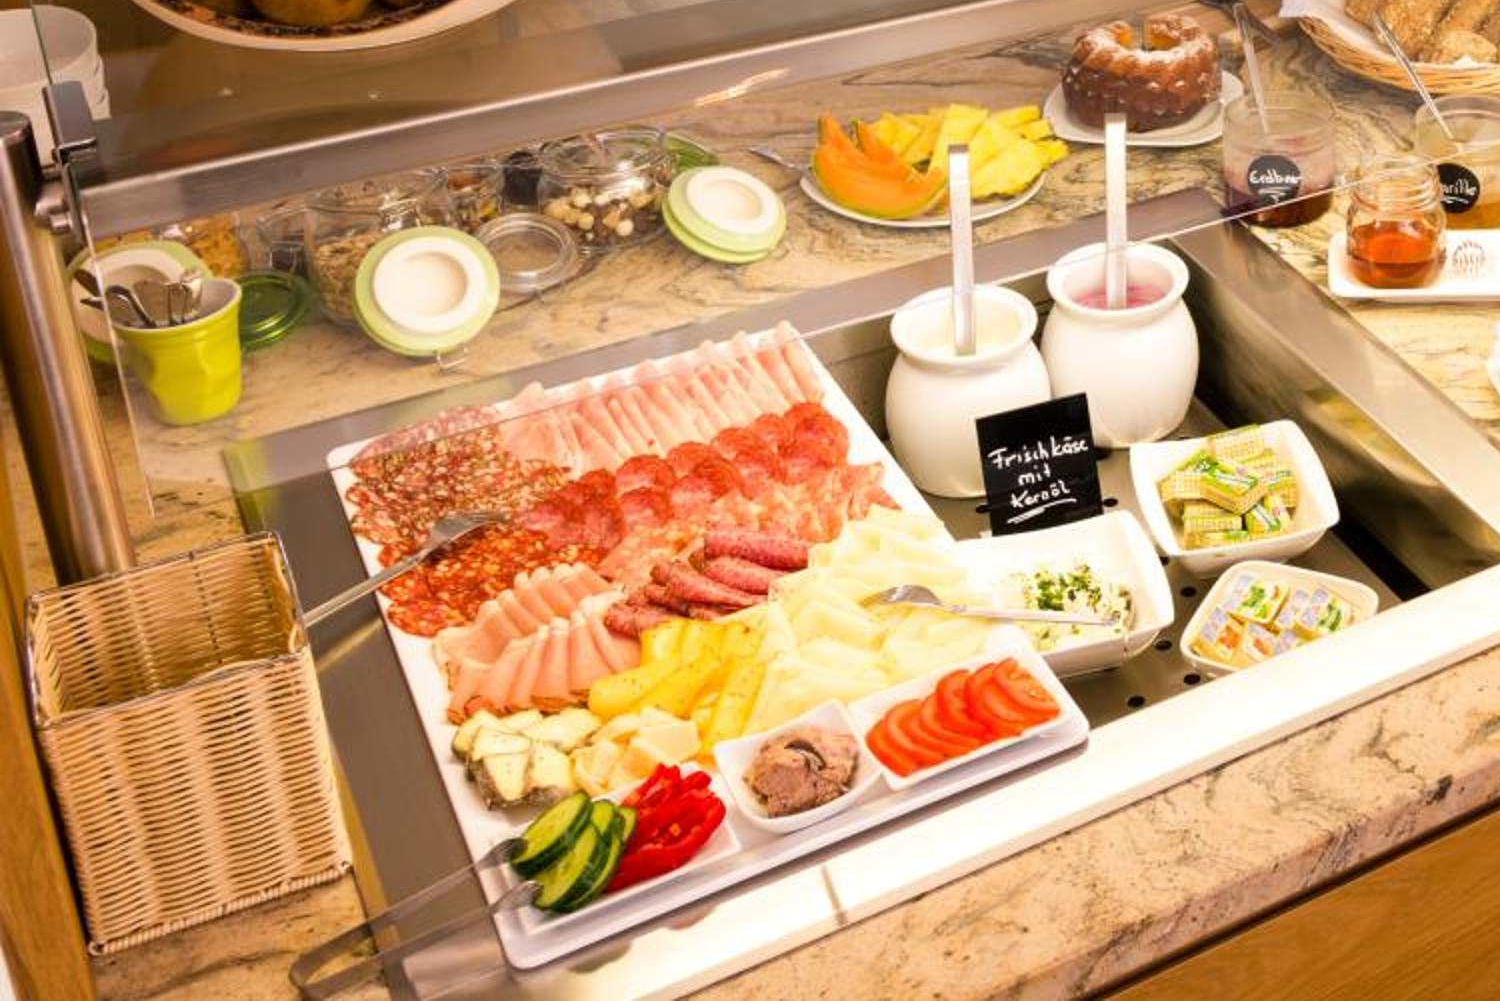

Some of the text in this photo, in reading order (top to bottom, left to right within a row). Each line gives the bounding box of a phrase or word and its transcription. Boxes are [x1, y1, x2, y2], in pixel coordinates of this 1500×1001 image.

[1440, 178, 1477, 196] arille
[988, 436, 1089, 469] Frischkäse
[1018, 463, 1051, 486] mit
[1010, 480, 1071, 508] Kernöl
